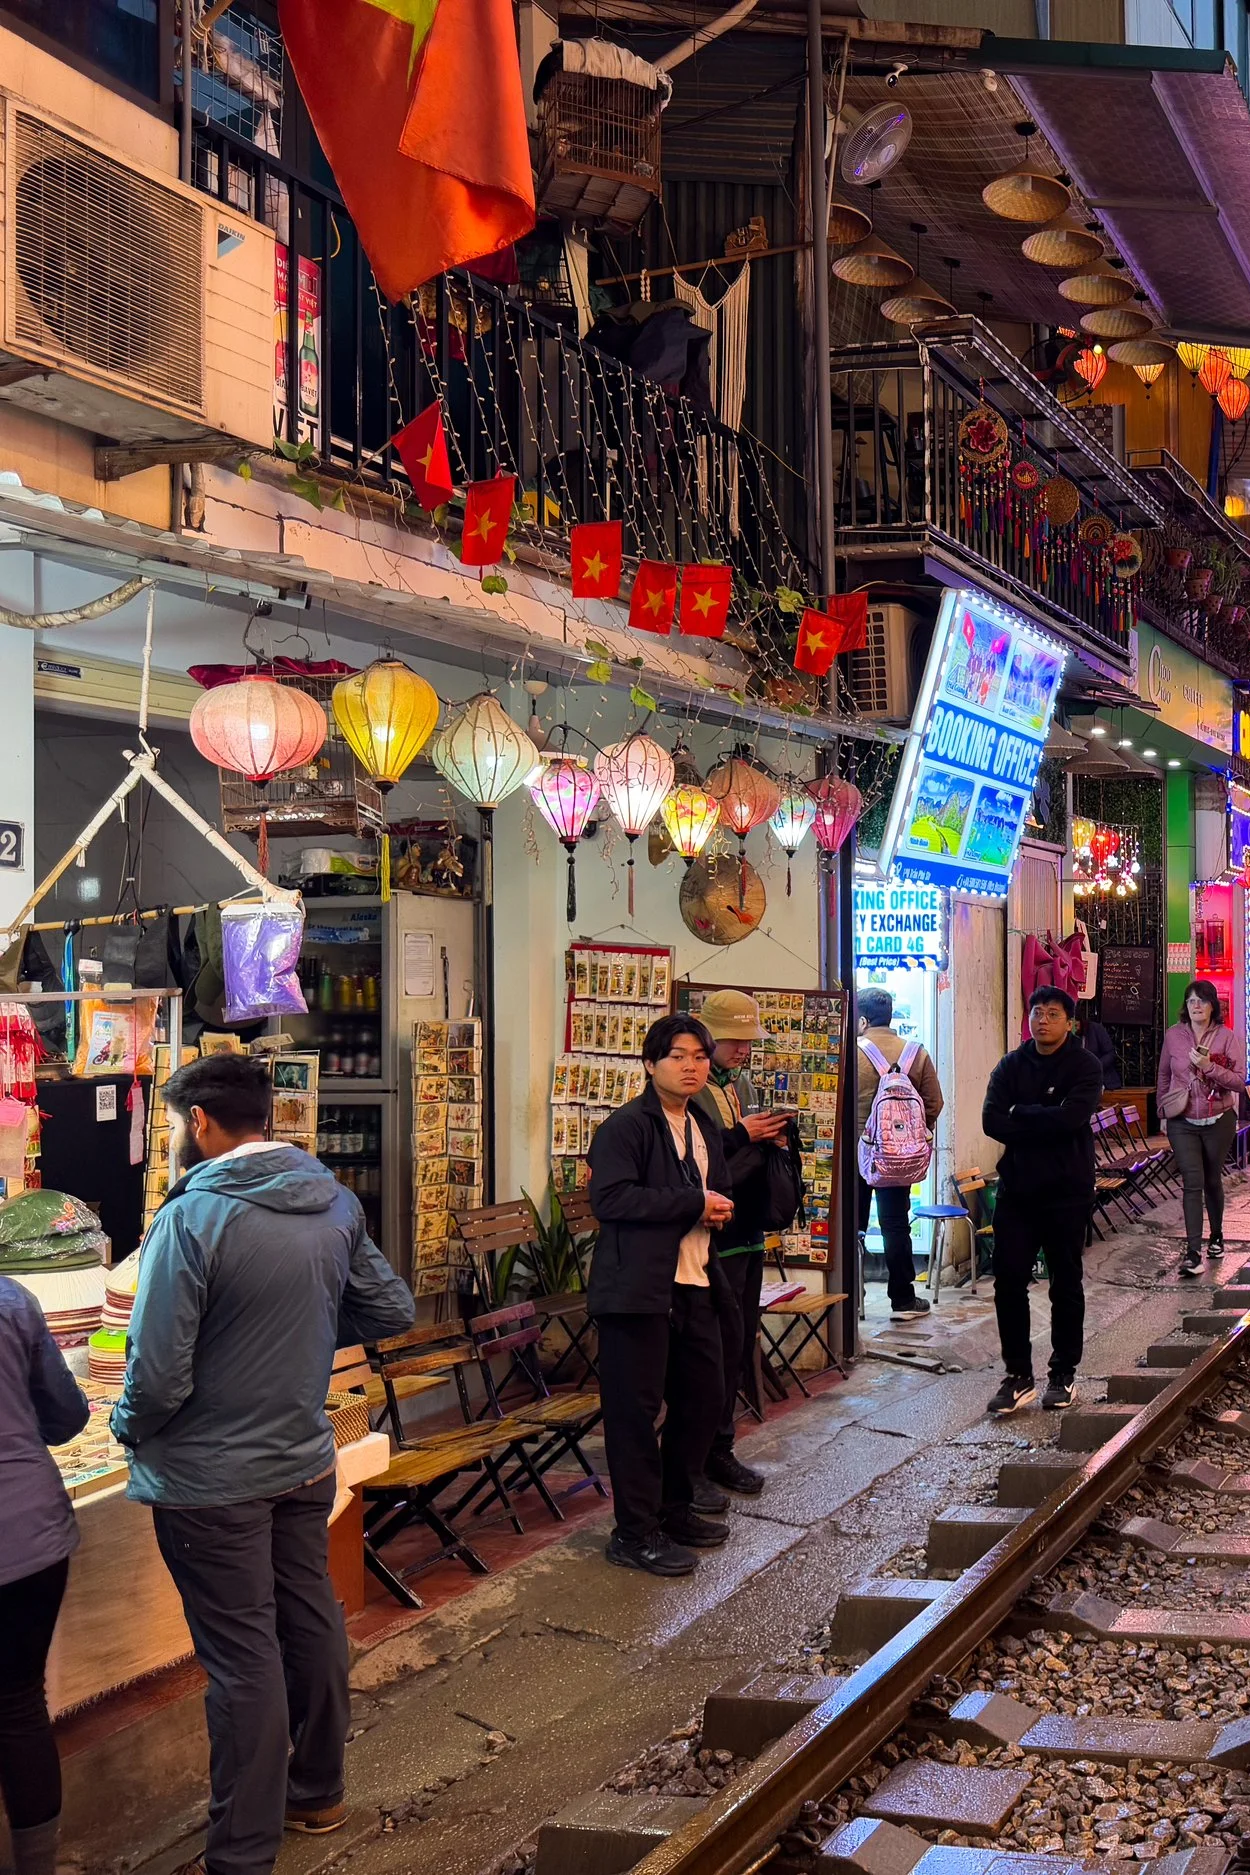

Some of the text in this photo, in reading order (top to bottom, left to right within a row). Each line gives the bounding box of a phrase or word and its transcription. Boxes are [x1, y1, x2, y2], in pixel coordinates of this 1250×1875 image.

[218, 223, 246, 241] DAIKIN
[926, 705, 1041, 786] BOOKING OFFICE
[890, 890, 937, 910] OFFICE
[350, 913, 378, 922] Alaska
[871, 914, 937, 932] EXCHANGE
[866, 936, 902, 953] CARD
[907, 936, 924, 953] 4G
